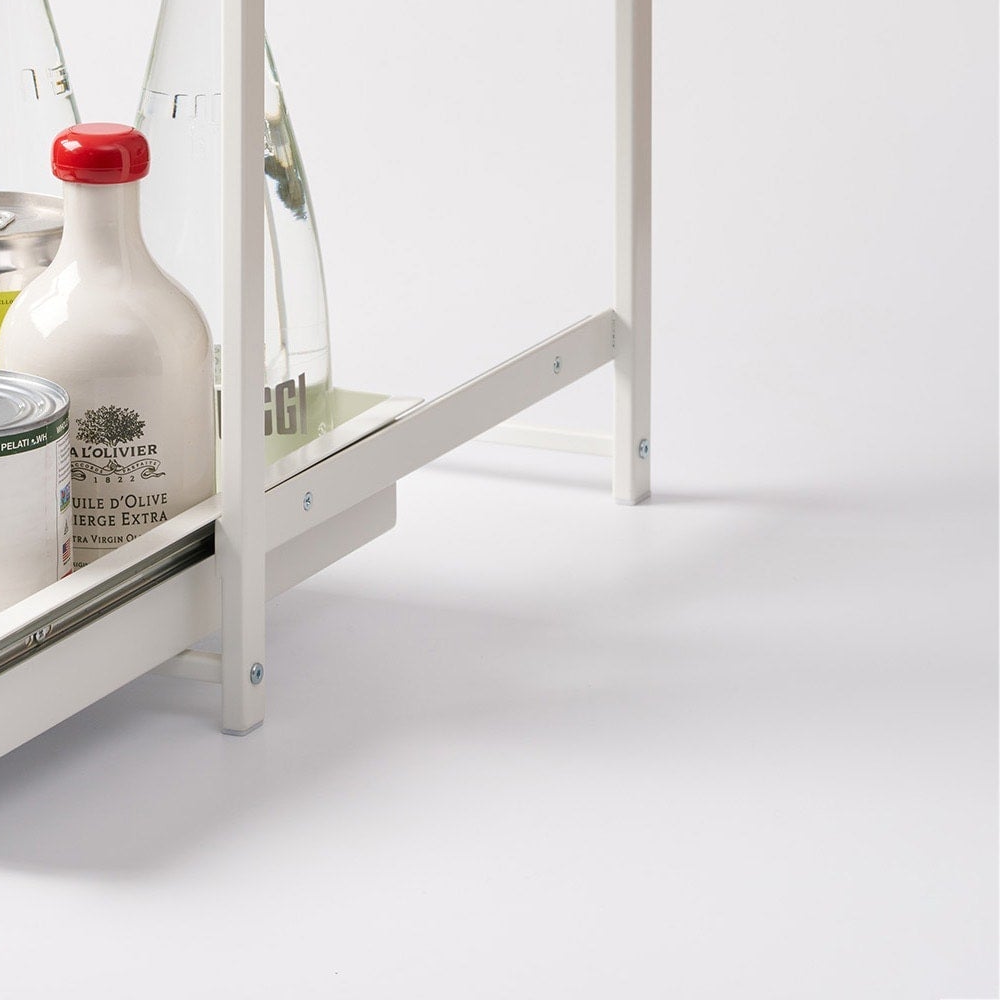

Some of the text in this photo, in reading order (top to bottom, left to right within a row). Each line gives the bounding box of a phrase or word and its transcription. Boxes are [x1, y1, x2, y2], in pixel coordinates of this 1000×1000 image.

[1, 438, 30, 451] PELATI
[72, 497, 104, 509] UILE
[73, 515, 116, 527] IERGE
